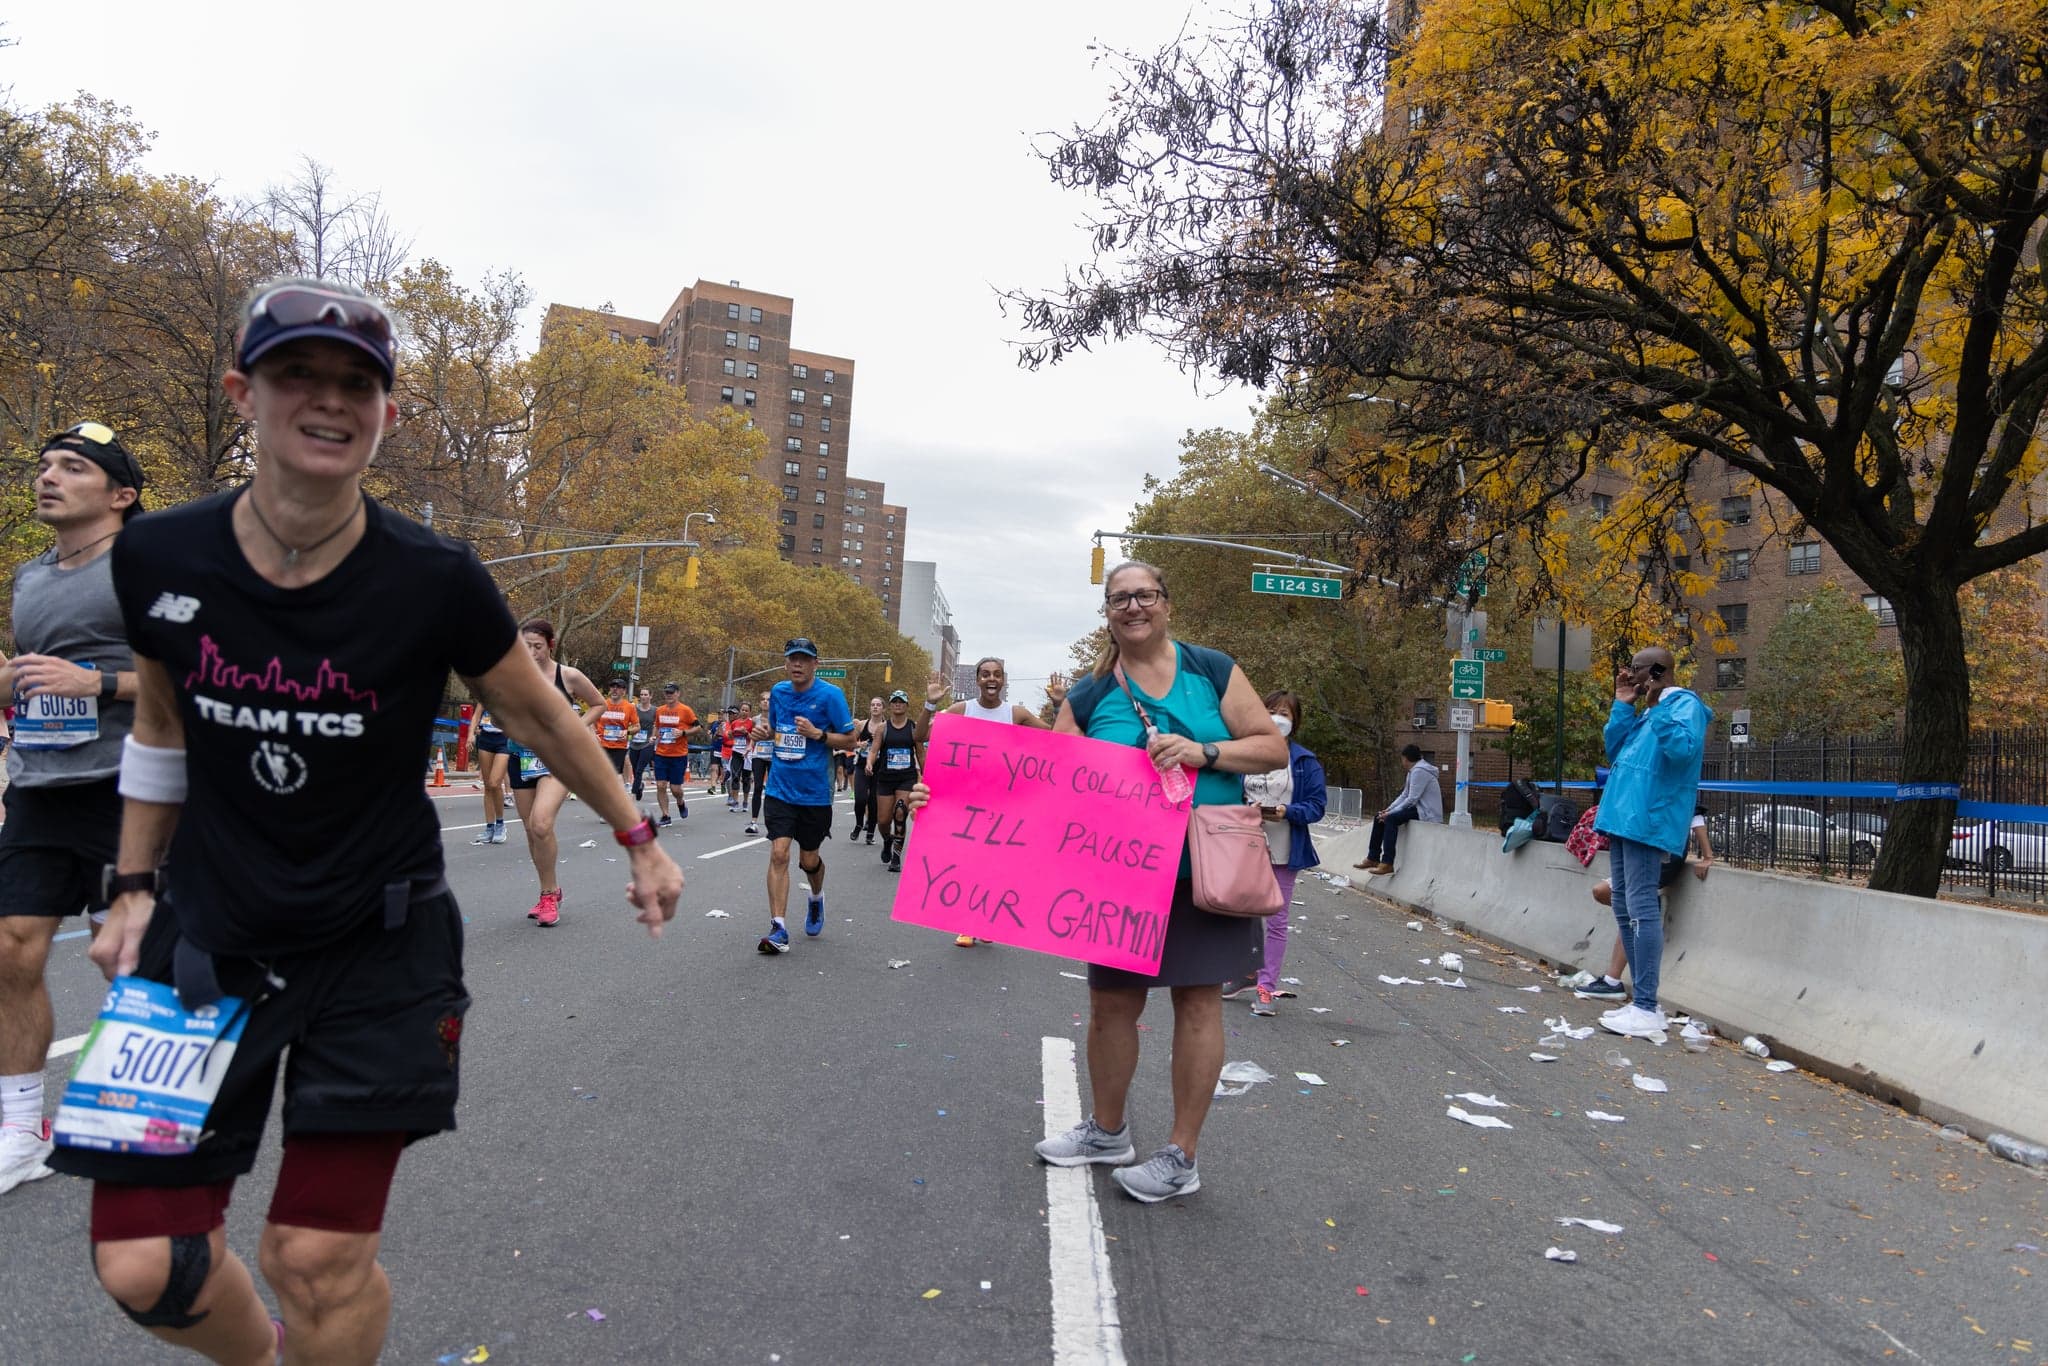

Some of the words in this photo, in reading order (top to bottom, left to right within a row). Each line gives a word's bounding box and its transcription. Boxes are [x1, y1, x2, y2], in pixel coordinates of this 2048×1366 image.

[1266, 578, 1275, 590] E
[1280, 579, 1306, 592] 124
[1312, 582, 1328, 594] St
[1483, 651, 1495, 661] 124
[194, 695, 289, 734] TEAM
[296, 712, 365, 737] TCS
[941, 741, 988, 769] IF
[1002, 752, 1057, 791] YOU
[951, 805, 1026, 846] I'LL
[1058, 822, 1165, 871] PAUSE
[111, 1031, 209, 1089] 51017
